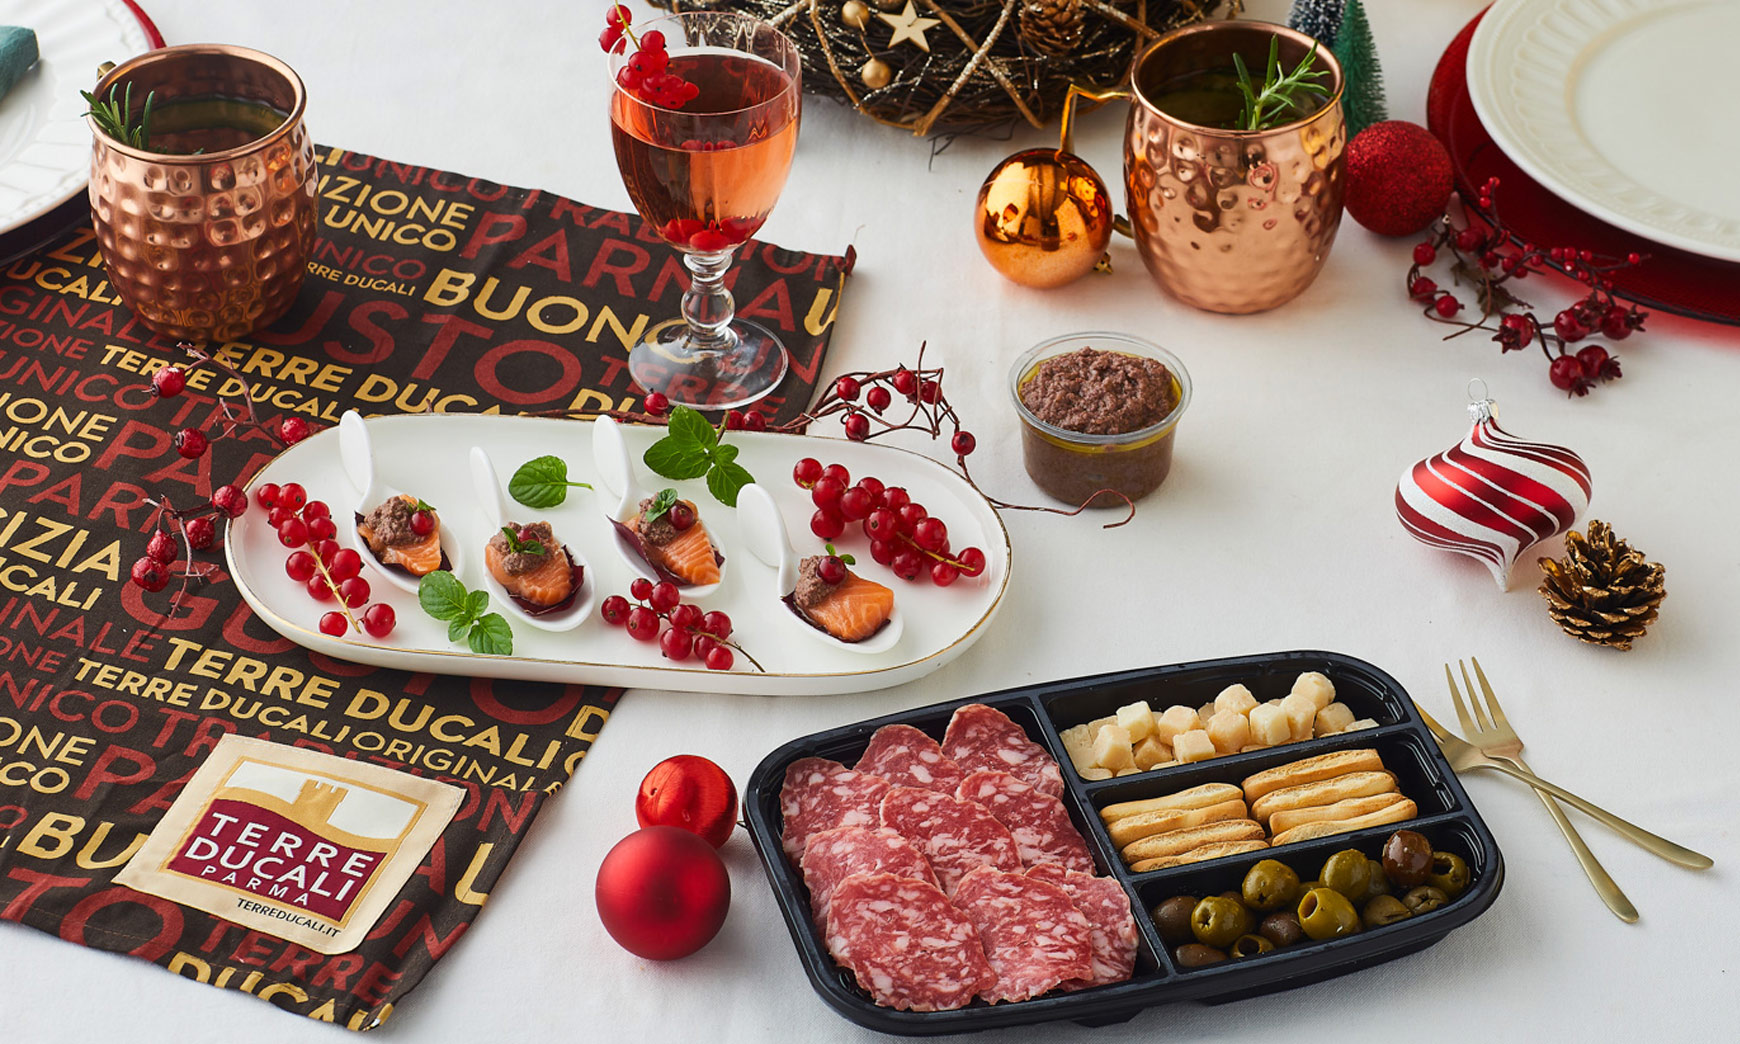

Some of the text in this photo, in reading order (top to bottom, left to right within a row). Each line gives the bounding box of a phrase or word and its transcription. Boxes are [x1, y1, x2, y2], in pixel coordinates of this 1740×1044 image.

[324, 204, 457, 251] UNICO
[344, 274, 416, 296] DUCALI
[186, 342, 353, 393] ERRE
[216, 377, 360, 423] DUCAL
[0, 506, 121, 582] IZIA
[0, 556, 103, 611] CALI
[74, 656, 198, 708] TERRE
[200, 687, 351, 743] DUCALI
[163, 637, 341, 709] TERRE
[344, 688, 562, 769] DUCALI
[184, 836, 355, 902] DUCALI
[211, 811, 375, 878] TERRE
[201, 865, 309, 906] PARMA
[238, 897, 342, 938] TERREDUCALI.IT
[200, 914, 402, 1007] TERRE
